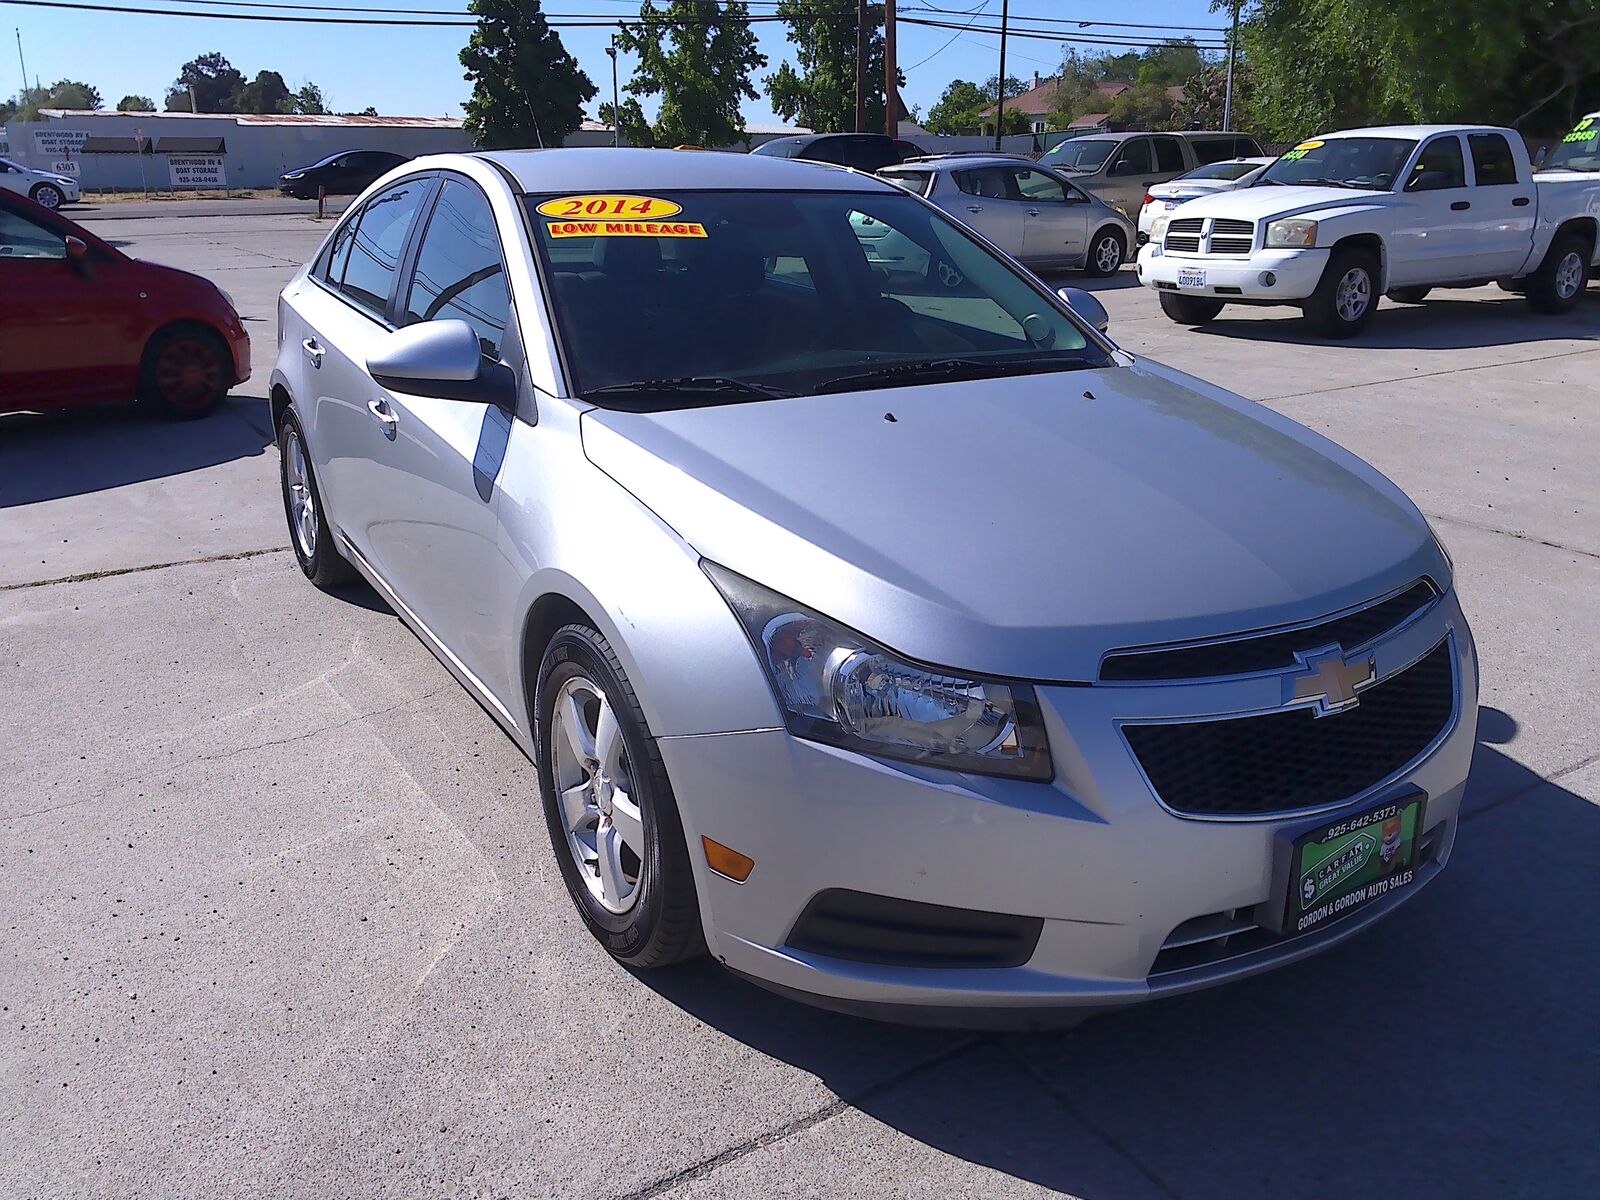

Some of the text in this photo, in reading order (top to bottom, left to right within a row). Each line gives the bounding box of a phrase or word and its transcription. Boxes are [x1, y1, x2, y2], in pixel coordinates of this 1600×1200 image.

[56, 162, 75, 172] 6303
[561, 199, 653, 216] 2014
[551, 223, 703, 235] LOW MILEAGE
[1327, 805, 1397, 840] 925-642-5373
[1318, 853, 1364, 890] GREAT VALUE
[1297, 870, 1414, 931] GORDON & GORDON AUTO SALES
